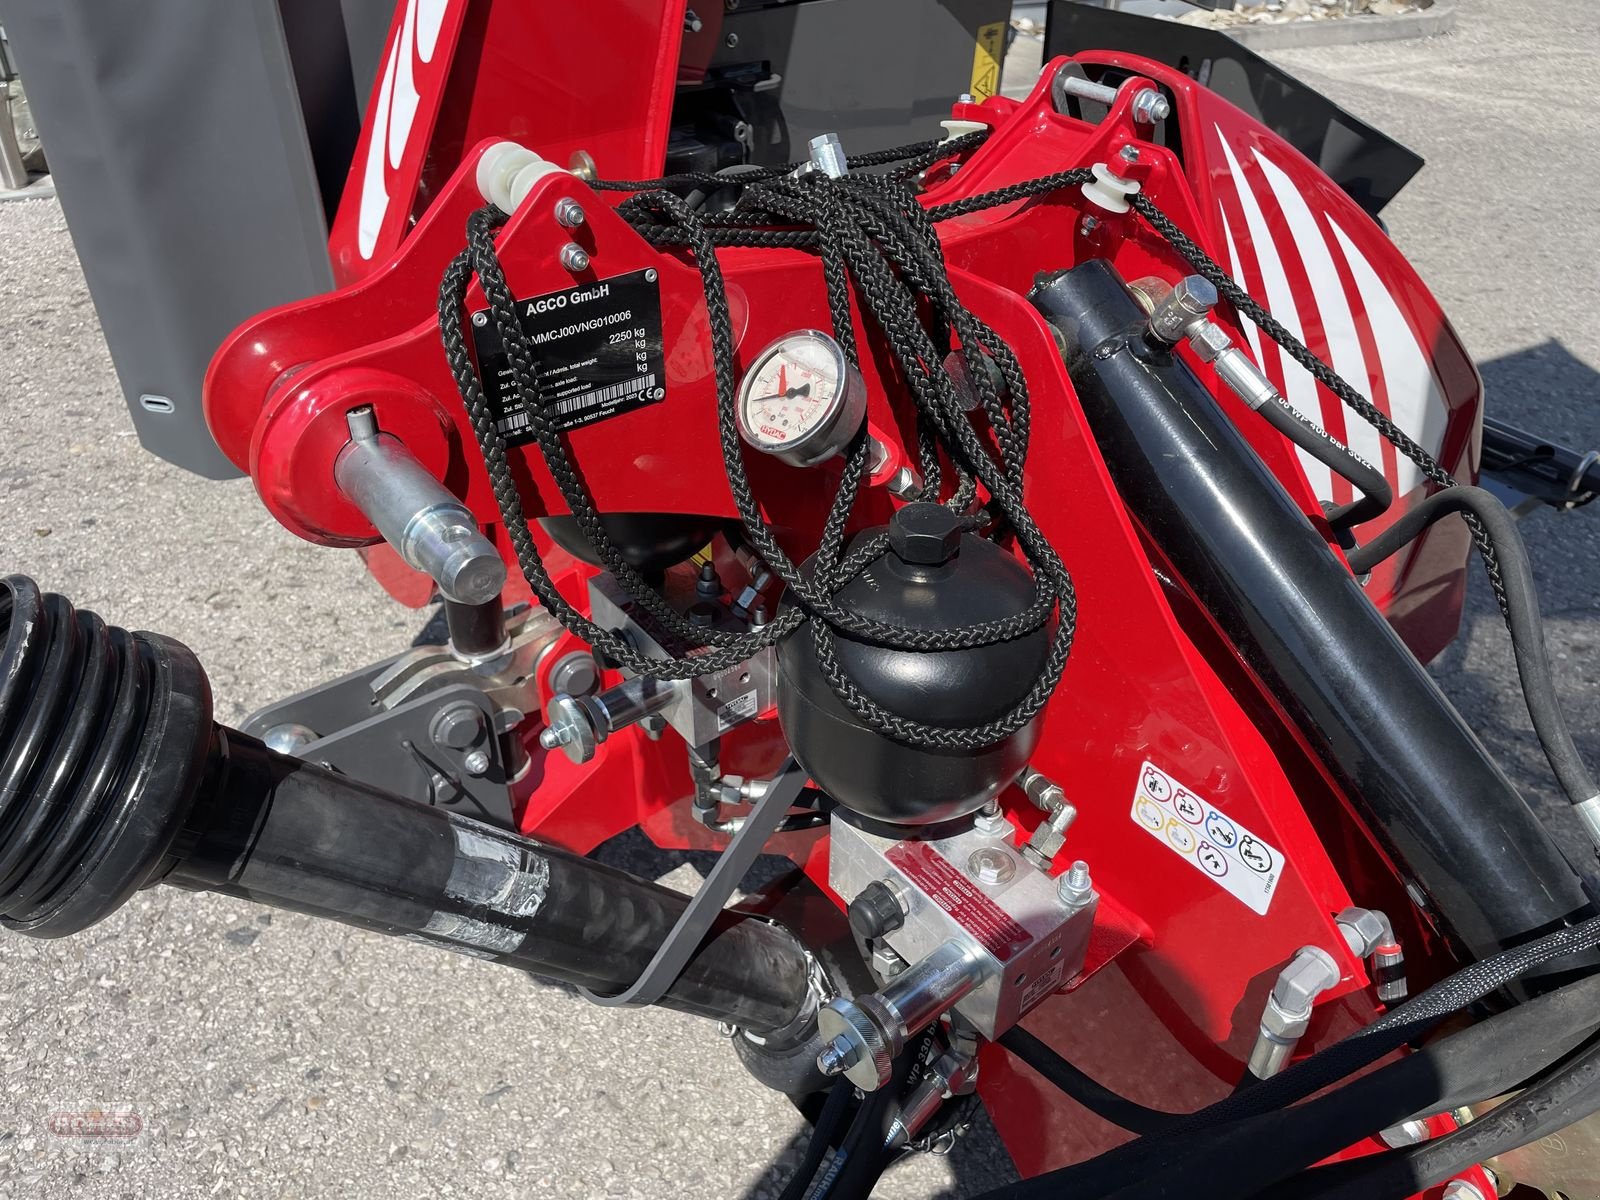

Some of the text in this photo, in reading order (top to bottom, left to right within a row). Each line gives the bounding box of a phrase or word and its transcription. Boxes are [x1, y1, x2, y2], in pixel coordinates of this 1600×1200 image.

[526, 284, 609, 316] AGCO GmbH
[525, 310, 631, 346] AMMCJ00VNG010006
[609, 328, 645, 344] 2250 kg
[635, 339, 646, 349] kg
[636, 351, 647, 361] kg
[637, 363, 648, 373] kg
[556, 386, 580, 397] supported
[625, 392, 638, 400] 2023
[501, 394, 512, 402] Zul.
[503, 405, 513, 413] Zul.
[583, 412, 598, 421] 90537
[598, 407, 615, 416] Feucht
[761, 426, 785, 439] HYDAC
[906, 1064, 921, 1086] WP
[918, 1037, 931, 1062] 330
